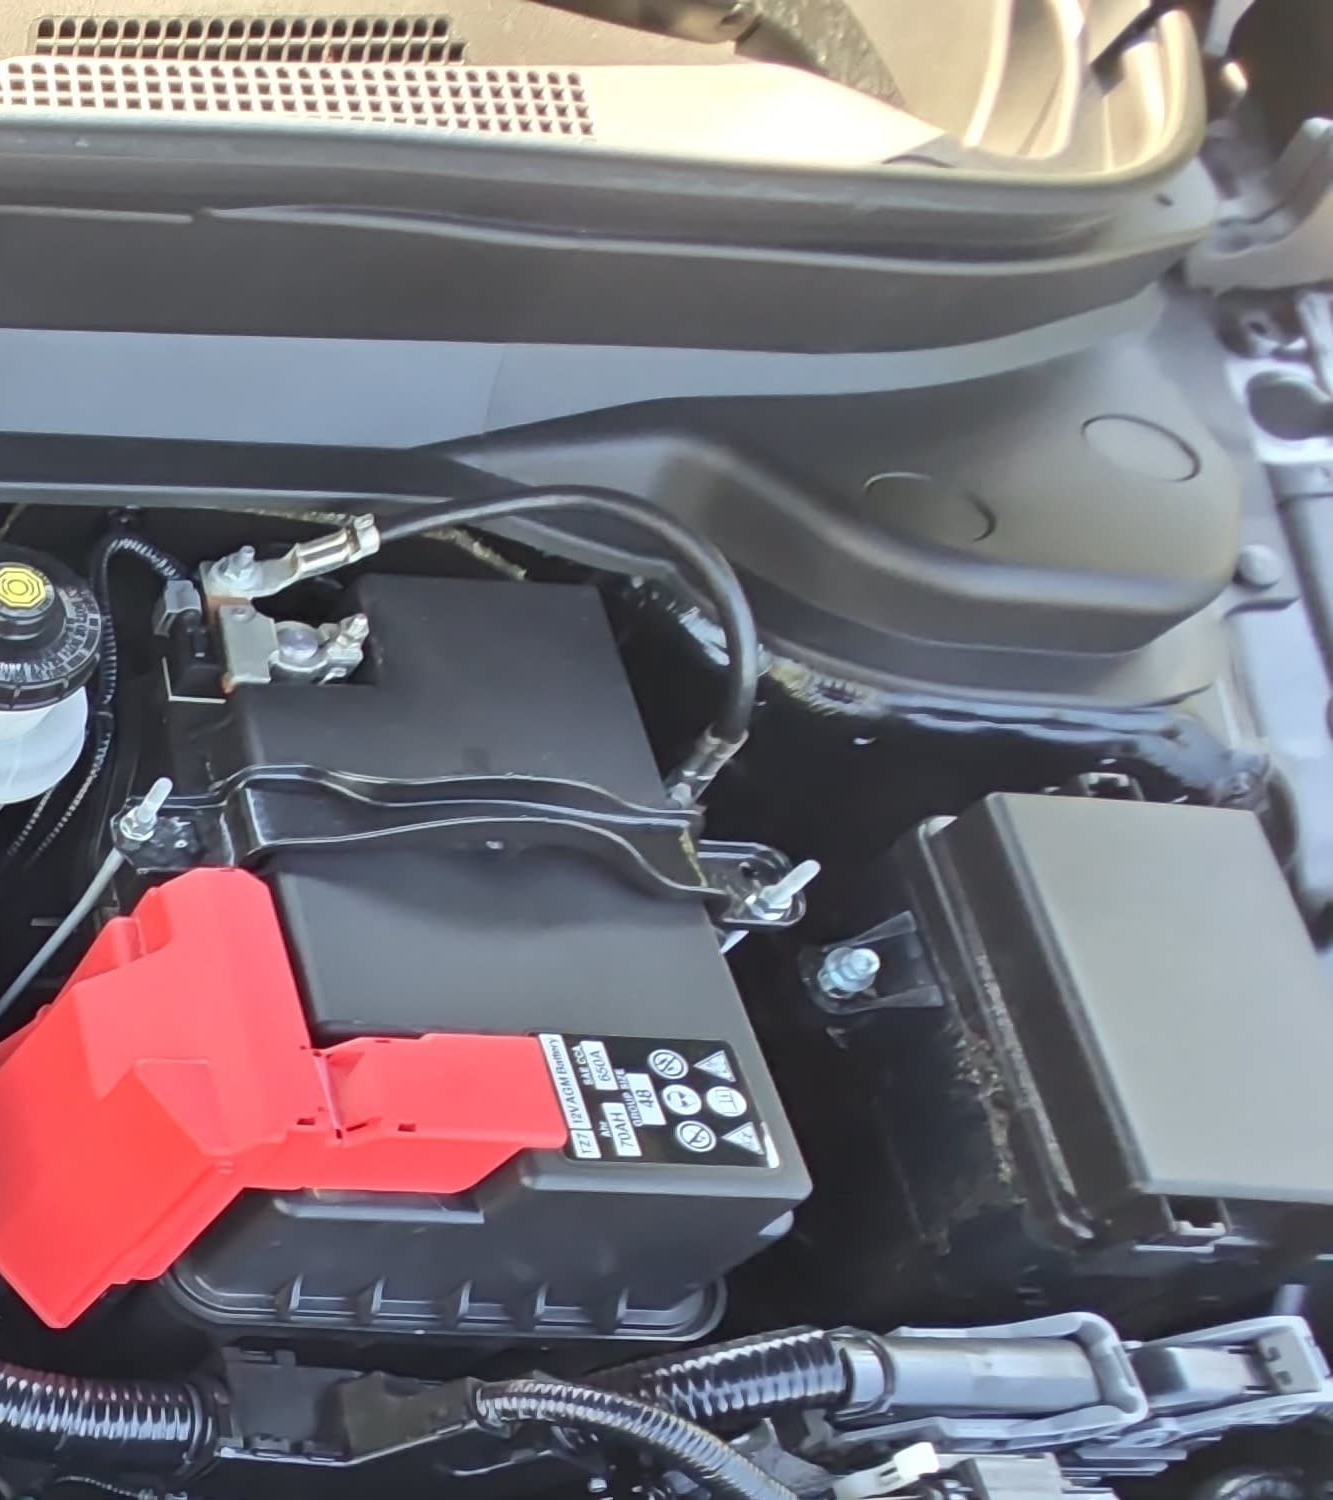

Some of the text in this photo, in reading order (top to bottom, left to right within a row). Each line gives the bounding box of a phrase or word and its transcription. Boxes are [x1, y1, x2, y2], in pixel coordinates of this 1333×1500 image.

[548, 1038, 567, 1075] Battery
[589, 1050, 611, 1082] 650A
[621, 1091, 643, 1127] GROUP
[635, 1089, 654, 1108] 48
[609, 1111, 634, 1148] 70AH
